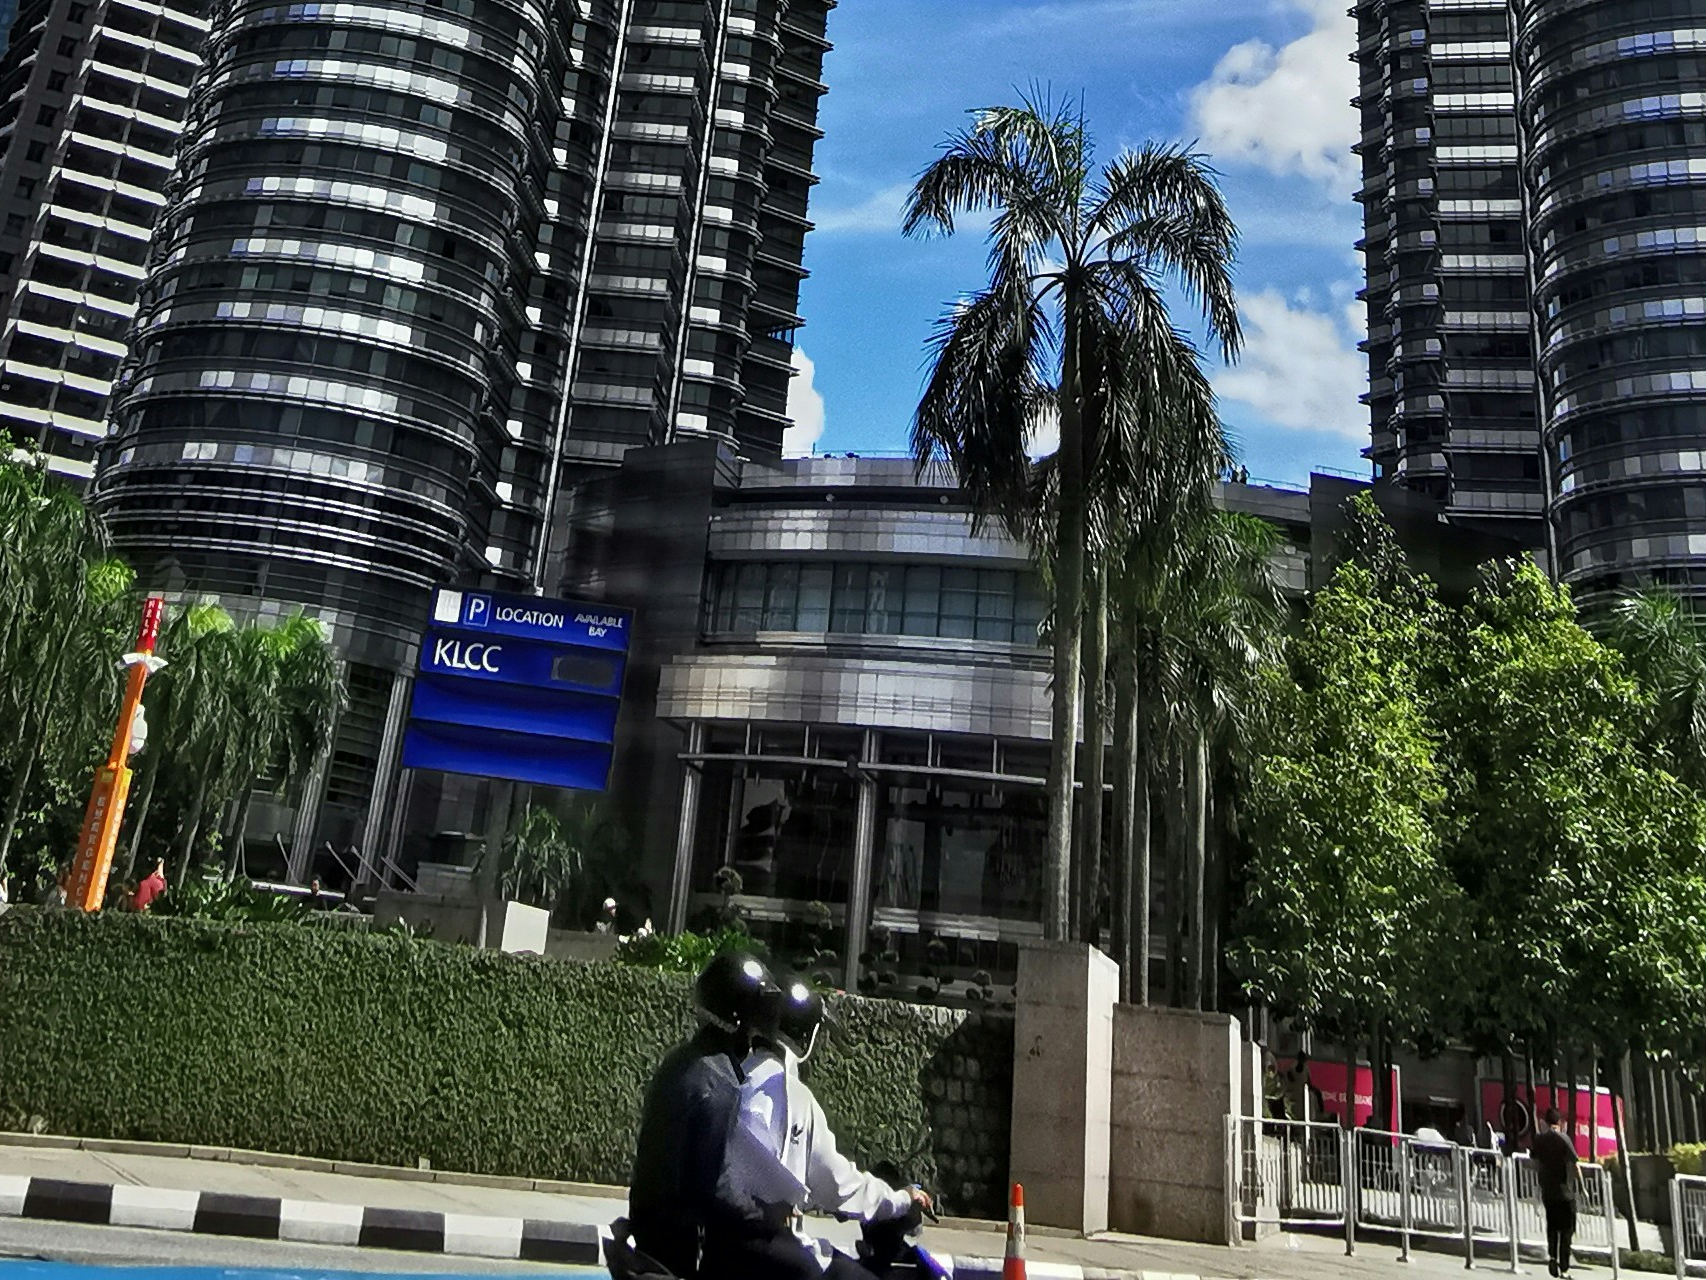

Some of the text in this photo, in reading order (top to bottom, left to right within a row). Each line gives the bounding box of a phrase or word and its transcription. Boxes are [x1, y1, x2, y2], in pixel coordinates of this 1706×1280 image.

[469, 598, 565, 629] P LOCATION
[574, 613, 624, 628] AVAILABLE
[588, 625, 608, 638] BAY
[433, 638, 503, 673] KLCC
